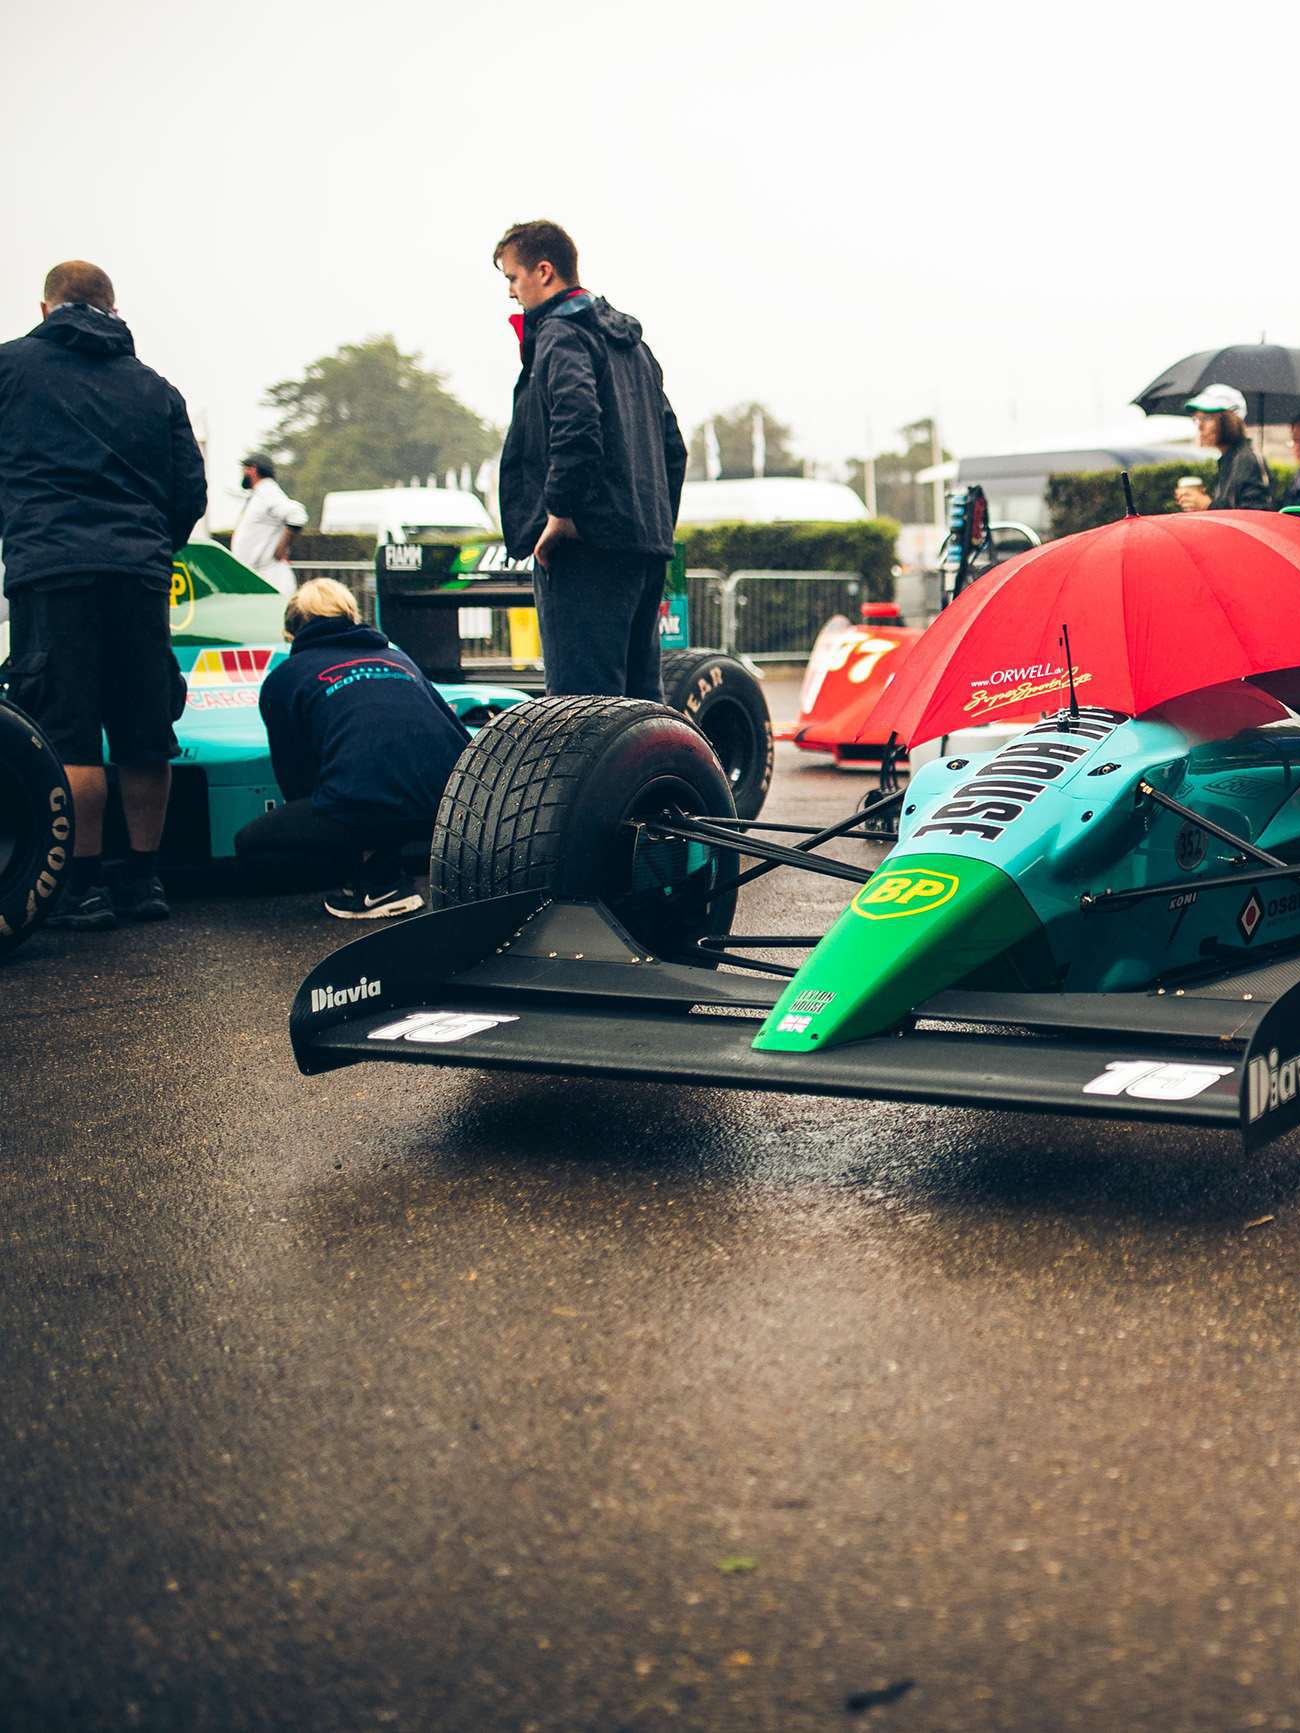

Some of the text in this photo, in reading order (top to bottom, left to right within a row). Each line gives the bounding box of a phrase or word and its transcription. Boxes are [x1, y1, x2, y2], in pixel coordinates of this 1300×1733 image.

[861, 877, 945, 904] BP
[1168, 892, 1198, 910] KONI
[311, 976, 382, 1013] Diavia
[789, 1000, 827, 1015] HOUSE
[367, 1011, 521, 1043] 15
[1083, 1061, 1235, 1100] 15
